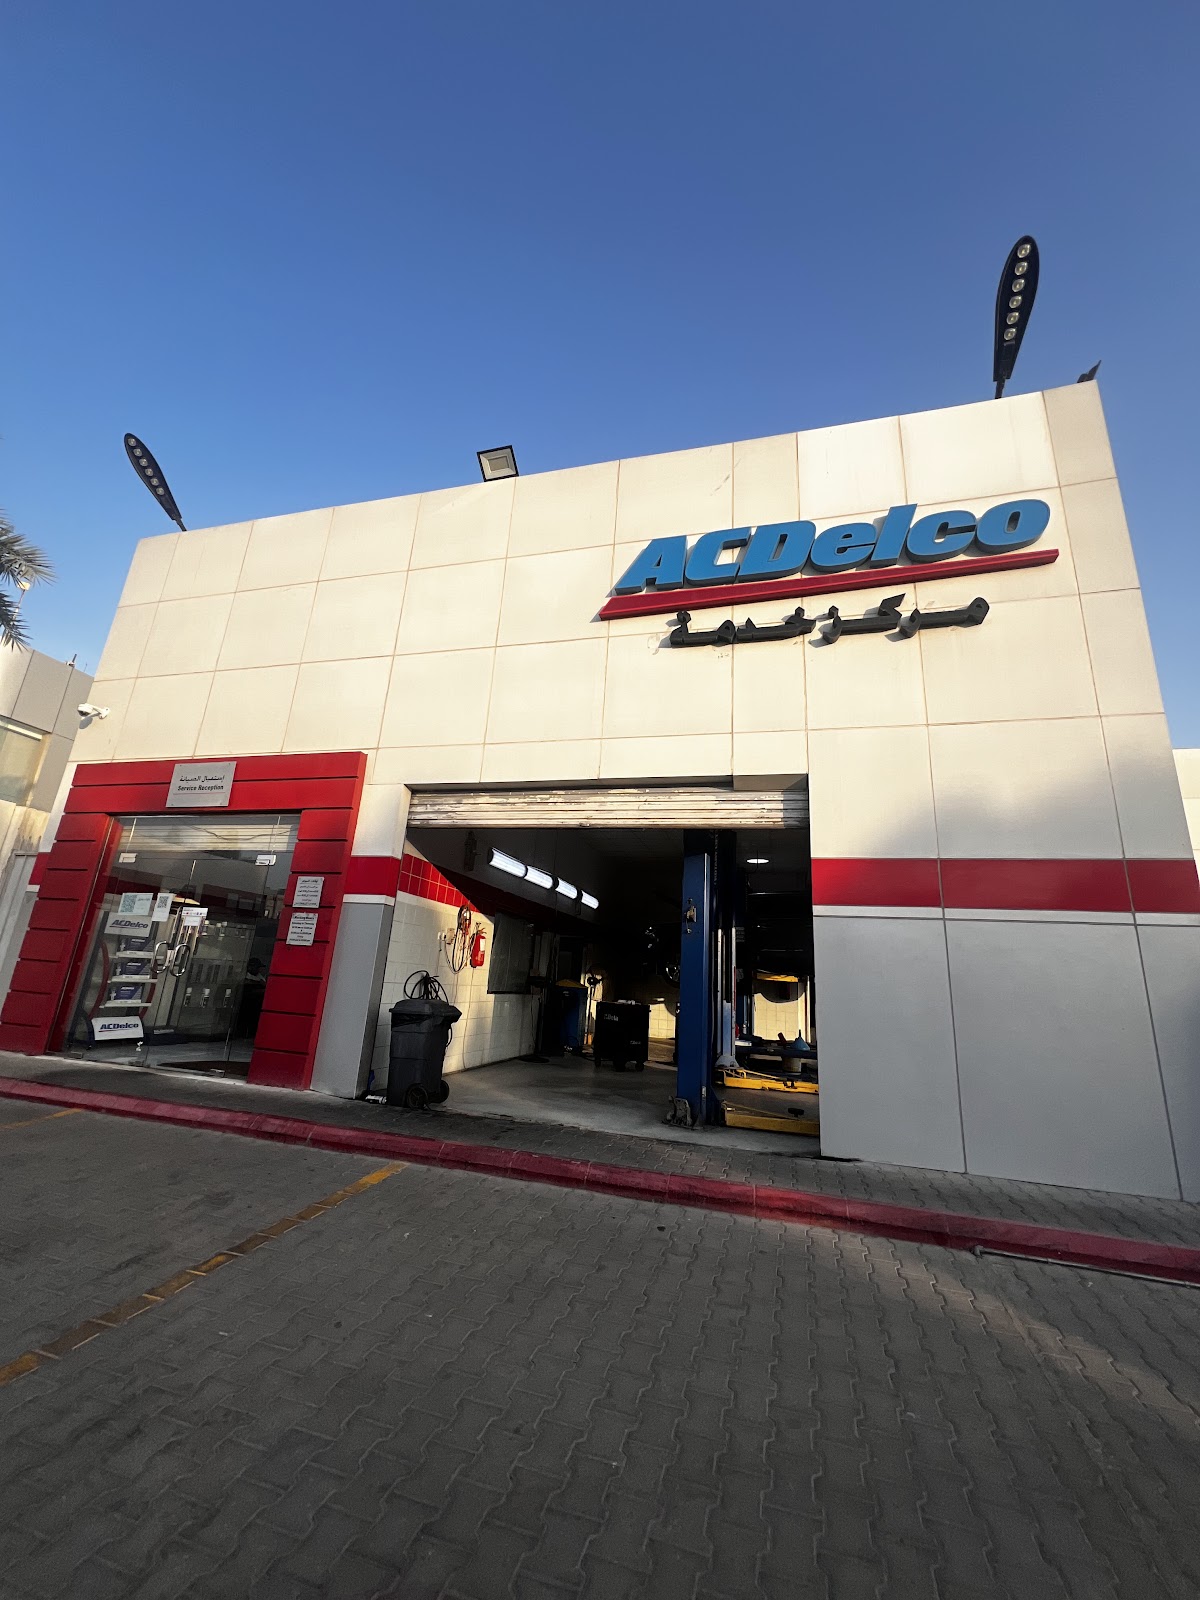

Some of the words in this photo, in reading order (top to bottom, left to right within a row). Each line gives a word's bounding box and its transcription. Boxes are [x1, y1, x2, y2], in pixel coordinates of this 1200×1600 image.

[613, 499, 1050, 595] ACDelco
[670, 606, 817, 647] خدمة
[823, 593, 990, 644] مركز
[197, 784, 224, 792] Reception
[111, 919, 149, 929] ACDelco
[100, 1022, 139, 1030] ACDelco
